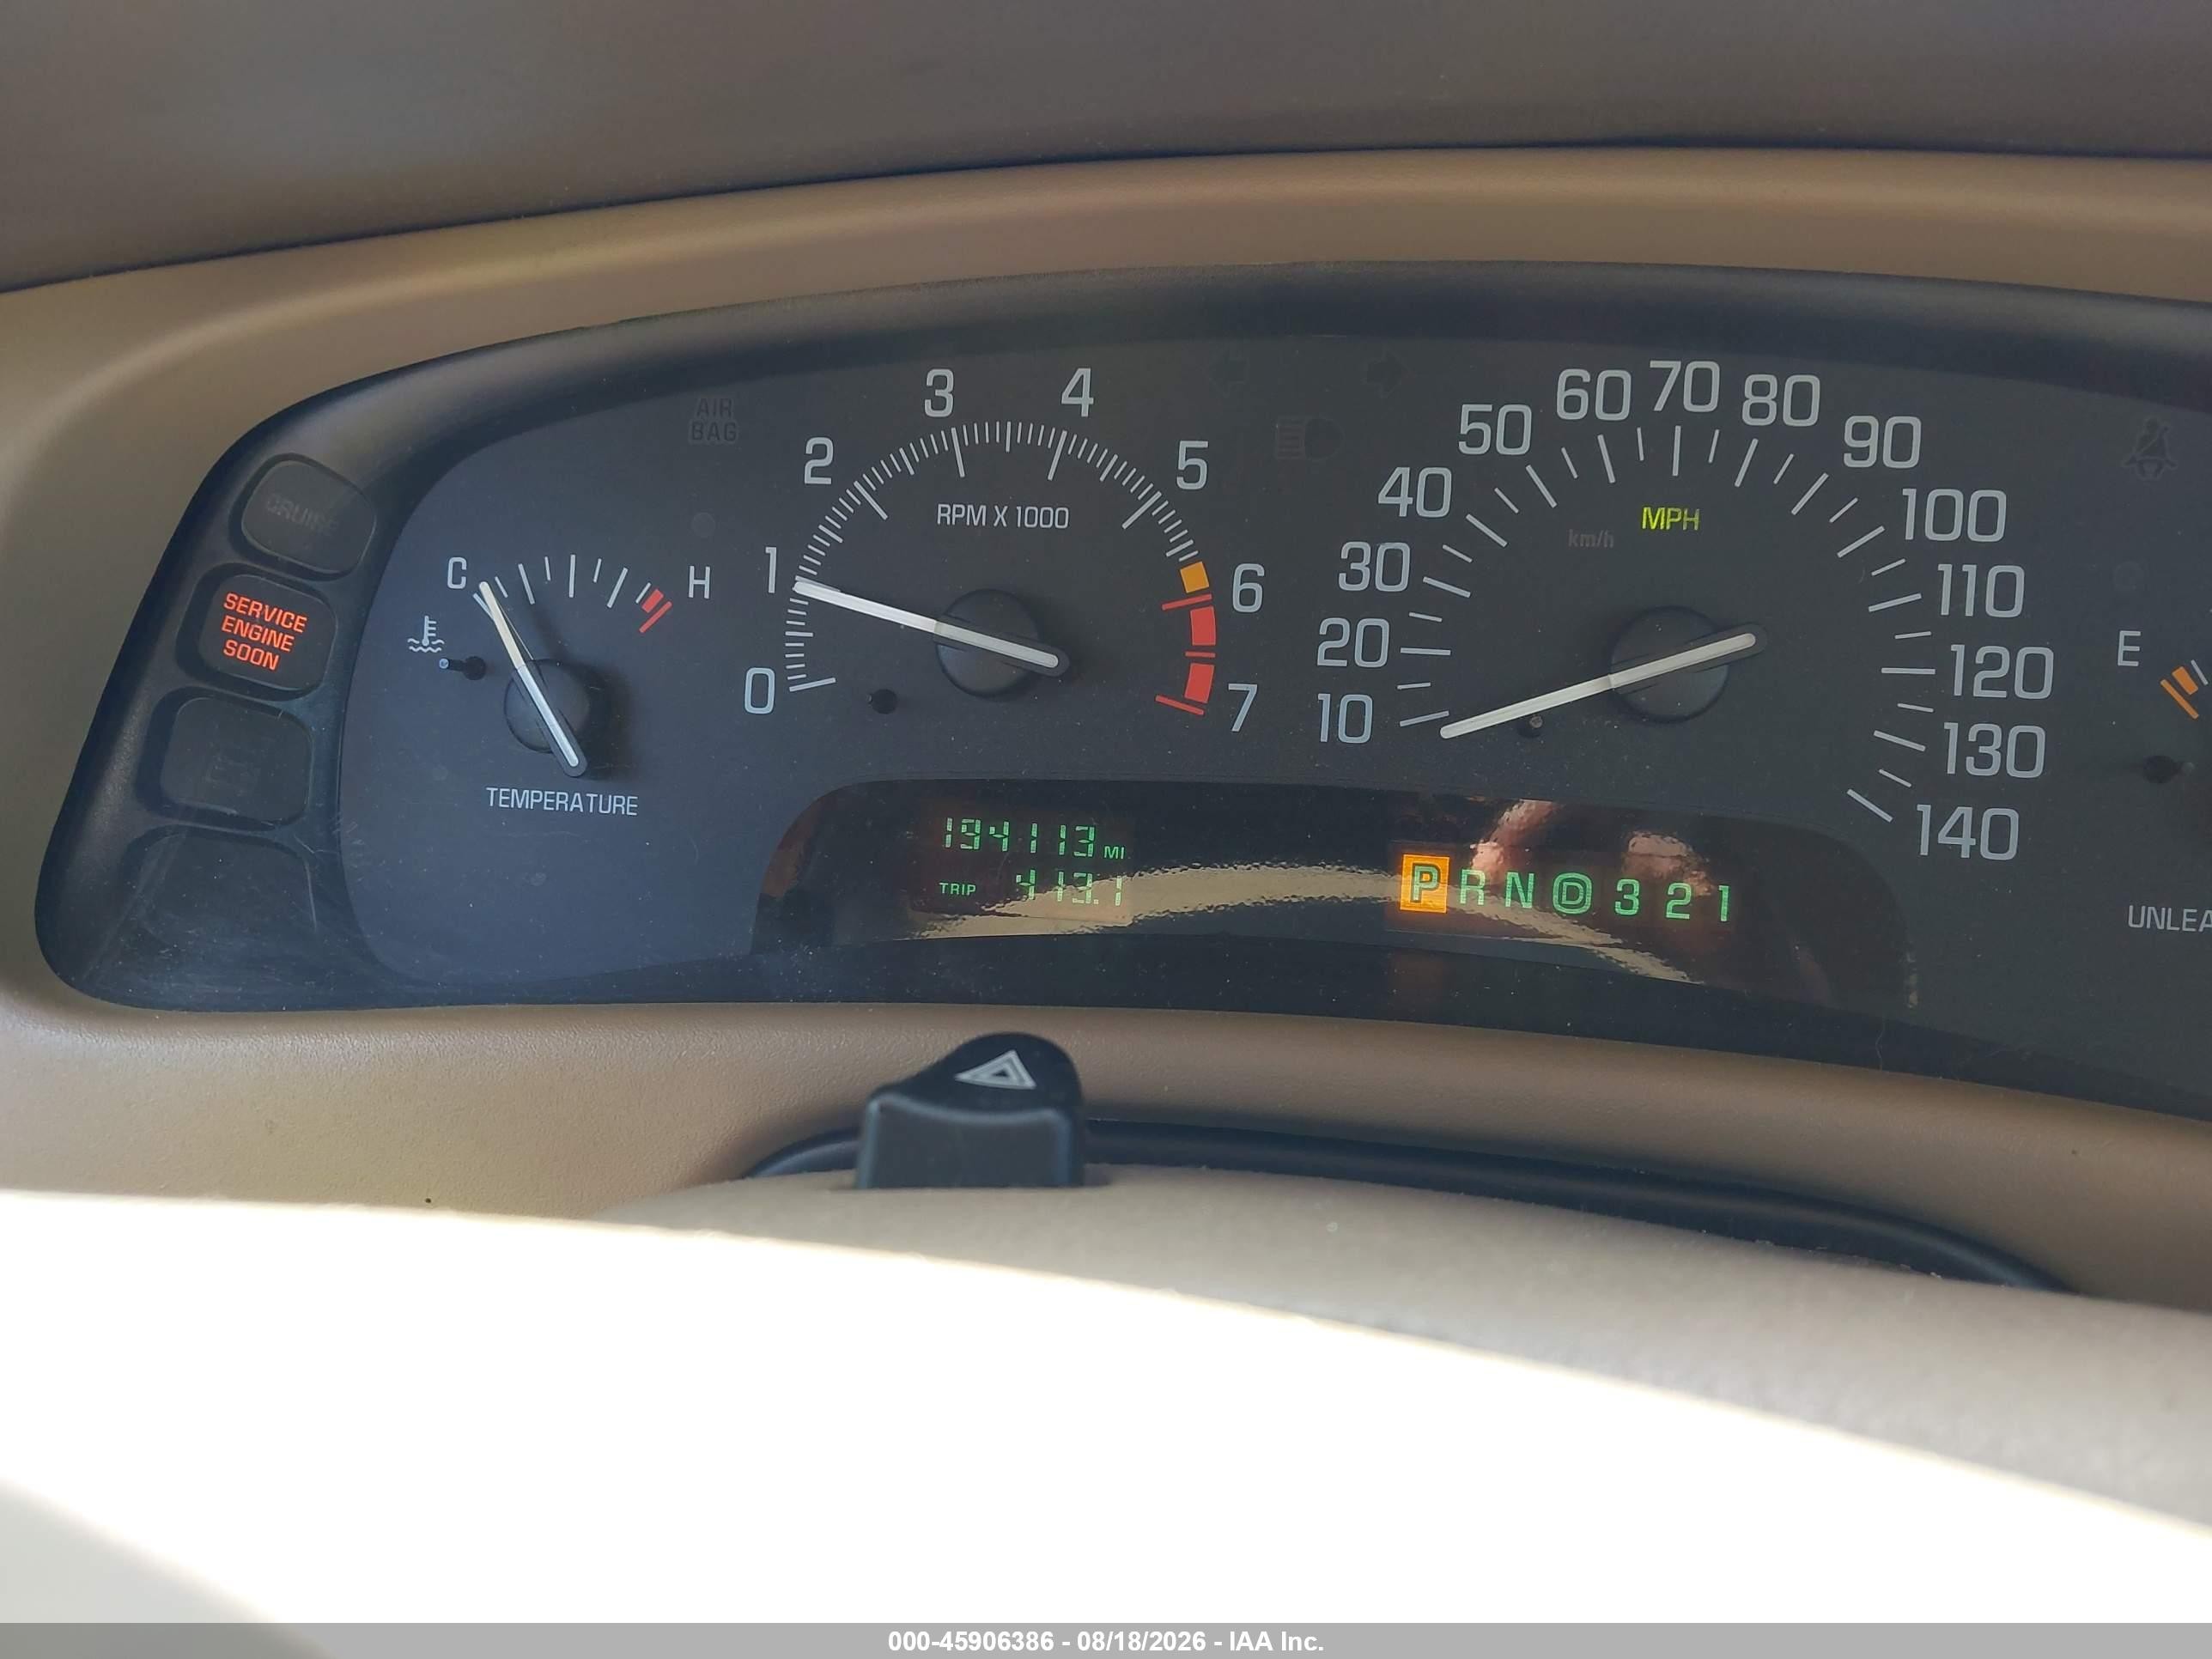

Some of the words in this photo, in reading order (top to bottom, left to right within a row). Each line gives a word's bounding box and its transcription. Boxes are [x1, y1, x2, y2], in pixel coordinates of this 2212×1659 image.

[696, 398, 732, 417] AIR
[925, 369, 953, 416] 3
[1061, 368, 1093, 416] 4
[1557, 369, 1631, 420] 60
[1650, 361, 1719, 412] 70
[1742, 374, 1820, 426] 80
[691, 421, 738, 442] BAG
[1459, 404, 1531, 455] 50
[1844, 416, 1921, 468] 90
[805, 437, 833, 484] 2
[1177, 441, 1208, 489] 5
[938, 504, 986, 526] RPM
[994, 506, 1007, 526] X
[1017, 507, 1068, 528] 1000
[1378, 467, 1451, 517] 40
[1903, 489, 2006, 542] 100
[1567, 528, 1615, 550] km/h
[1643, 507, 1698, 530] MPH
[447, 557, 466, 588] C
[689, 566, 710, 599] H
[766, 547, 776, 592] 1
[1233, 563, 1264, 612] 6
[1339, 542, 1410, 592] 30
[1938, 564, 2024, 617] 110
[221, 615, 295, 653] ENGINE
[222, 592, 307, 634] SERVICE
[222, 639, 280, 672] SOON
[1317, 617, 1389, 667] 20
[2118, 630, 2141, 666] E
[745, 668, 775, 714] 0
[1951, 645, 2053, 699] 120
[1229, 684, 1257, 732] 7
[1318, 694, 1372, 743] 10
[1944, 722, 2045, 778] 130
[486, 787, 637, 815] TEMPERATURE
[945, 817, 1095, 857] 194113
[1103, 845, 1125, 860] MI
[1917, 805, 2019, 860] 140
[939, 881, 977, 897] TRIP
[1413, 865, 1438, 902] P
[1460, 869, 1486, 906] R
[1505, 872, 1535, 908] N
[1615, 878, 1640, 916] 3
[1666, 883, 1692, 920] 2
[1718, 884, 1732, 922] 1
